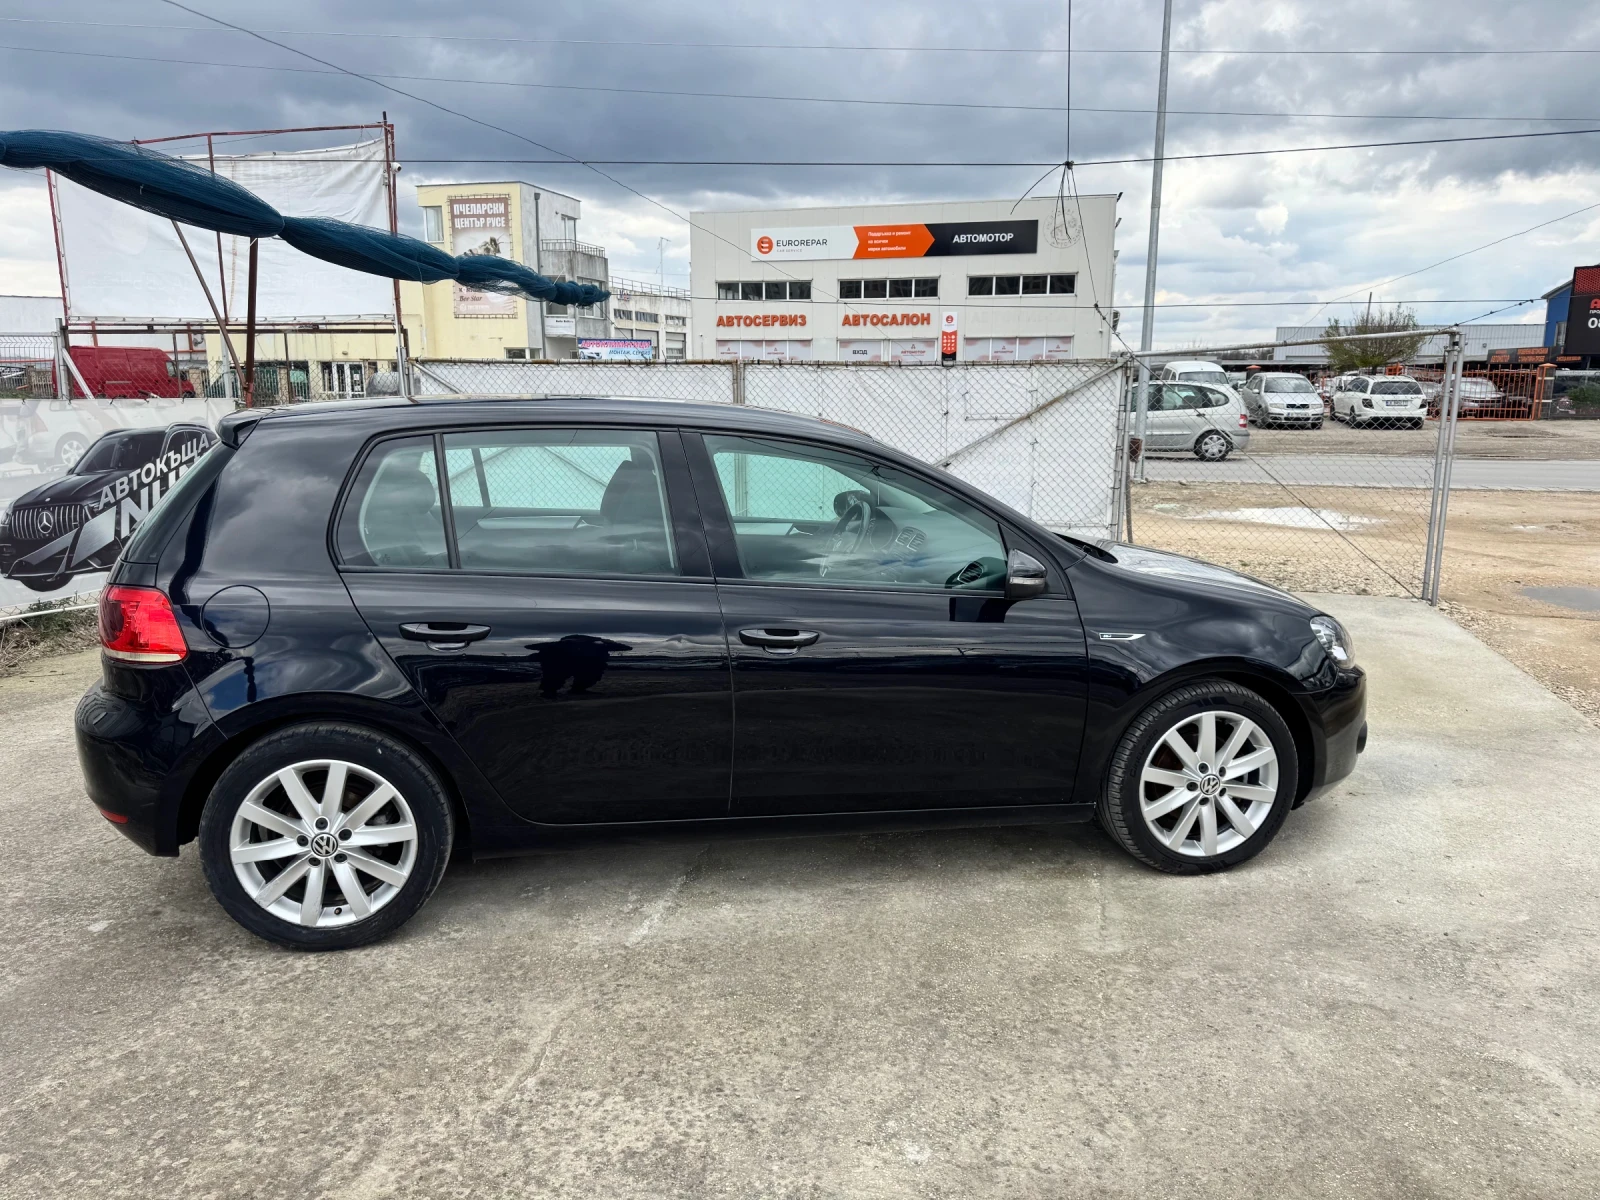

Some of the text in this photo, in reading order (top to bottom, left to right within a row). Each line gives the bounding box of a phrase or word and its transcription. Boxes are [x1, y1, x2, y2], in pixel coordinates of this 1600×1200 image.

[453, 203, 505, 215] ПЧЕЛАРСКИ
[454, 217, 506, 230] ЦЕНТЪР РУСЕ
[776, 239, 828, 247] EUROREPAR
[953, 233, 1014, 243] АВТОМОТОР
[716, 314, 807, 327] АВТОСЕРВИЗ
[842, 312, 931, 326] АВТОСАЛОН
[99, 433, 209, 511] АВТОКЪЩА
